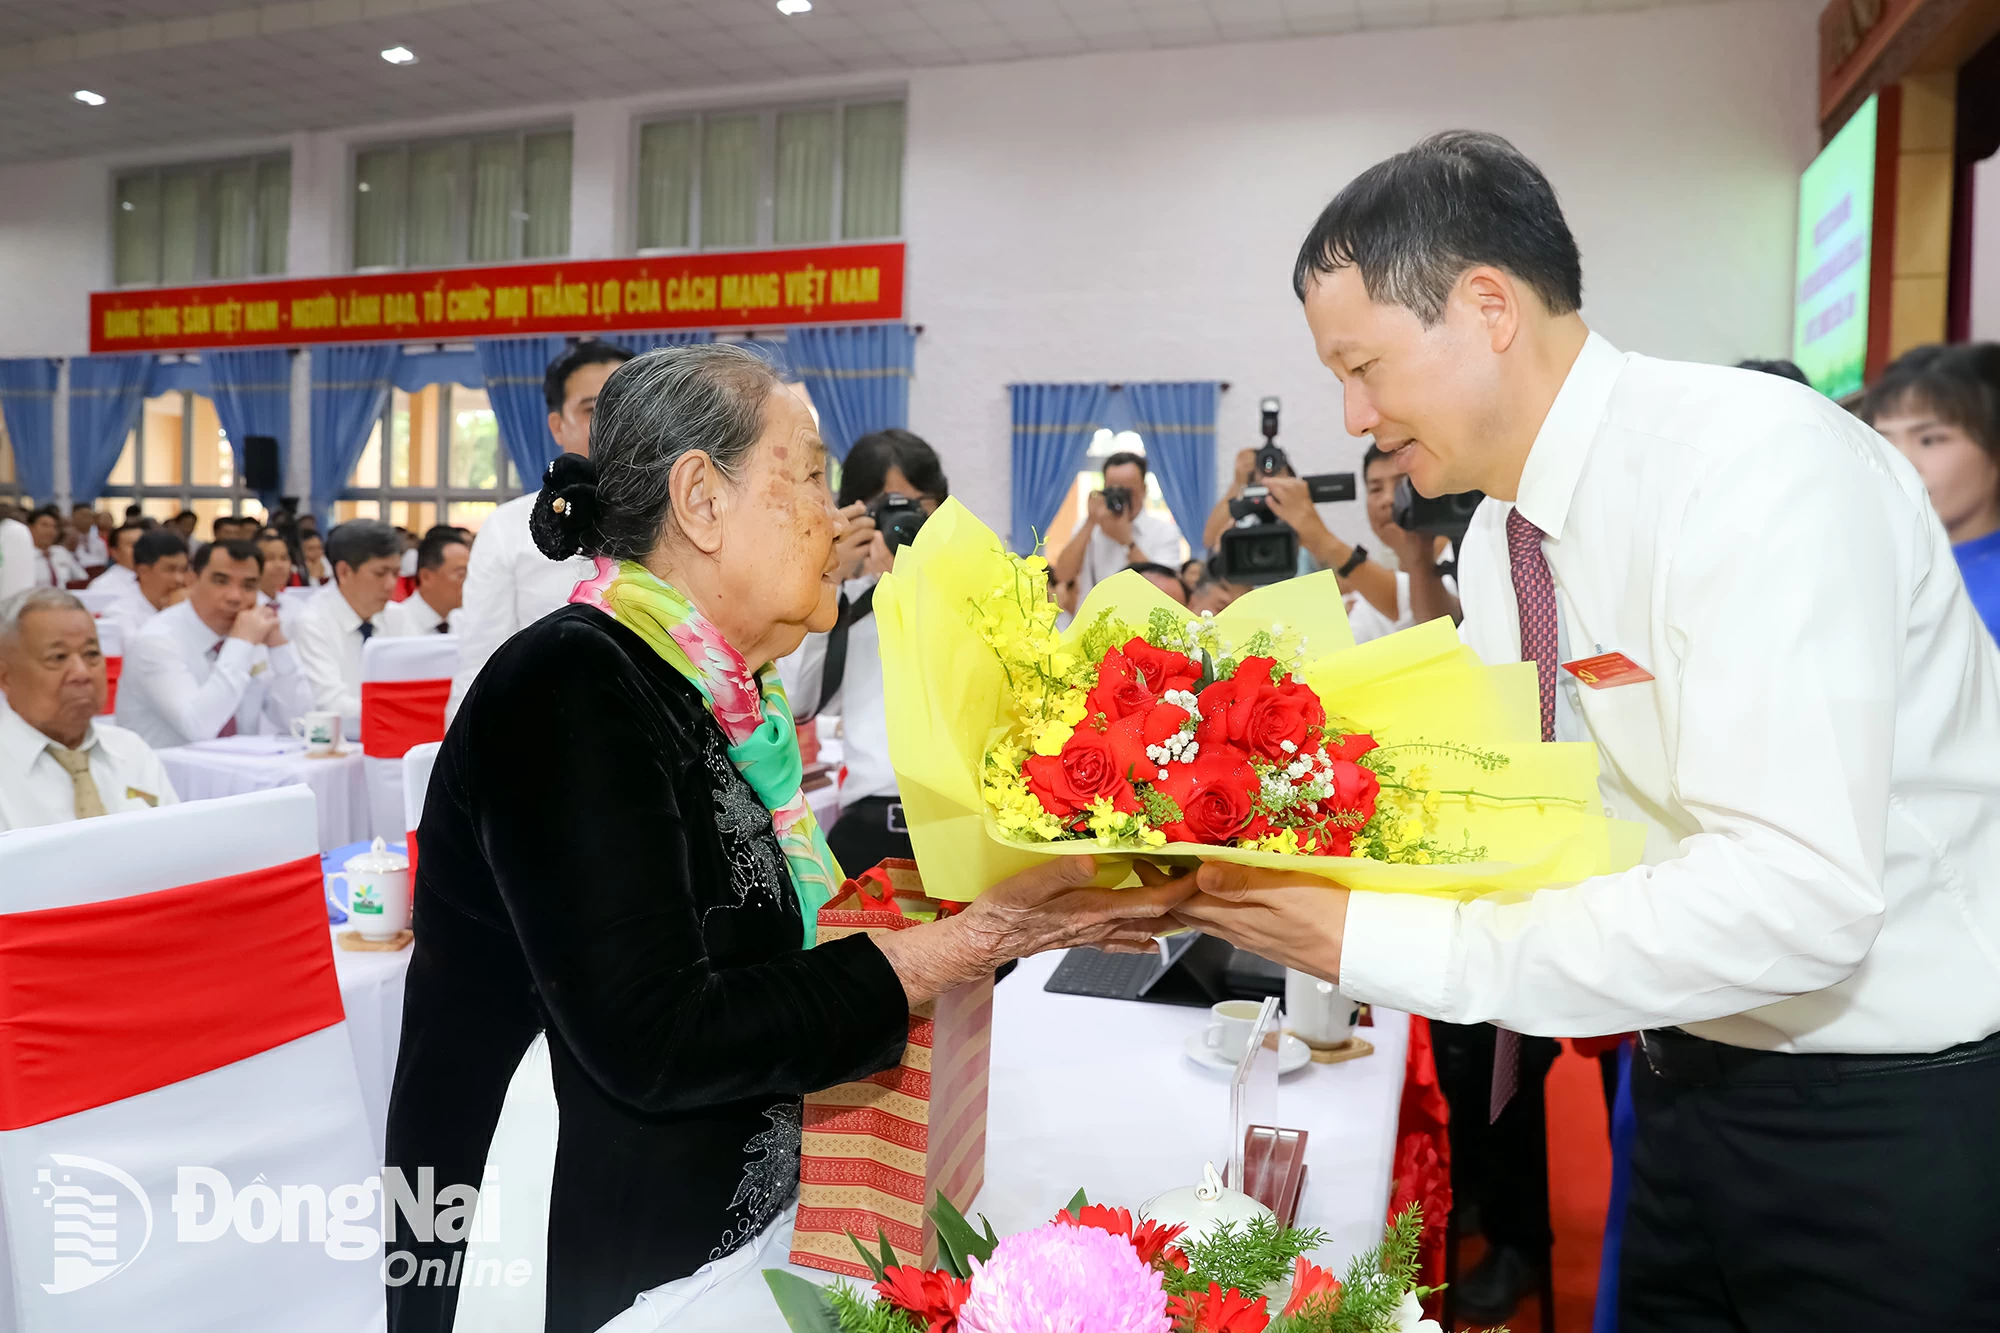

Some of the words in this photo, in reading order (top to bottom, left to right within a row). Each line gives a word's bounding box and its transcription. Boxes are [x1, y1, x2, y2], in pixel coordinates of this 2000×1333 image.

[213, 296, 242, 339] VIỆT
[245, 300, 279, 331] NAM
[624, 268, 662, 314] CỦA
[666, 269, 717, 312] CÁCH
[720, 272, 780, 317] MẠNG
[784, 263, 827, 315] VIỆT
[830, 267, 880, 303] NAM
